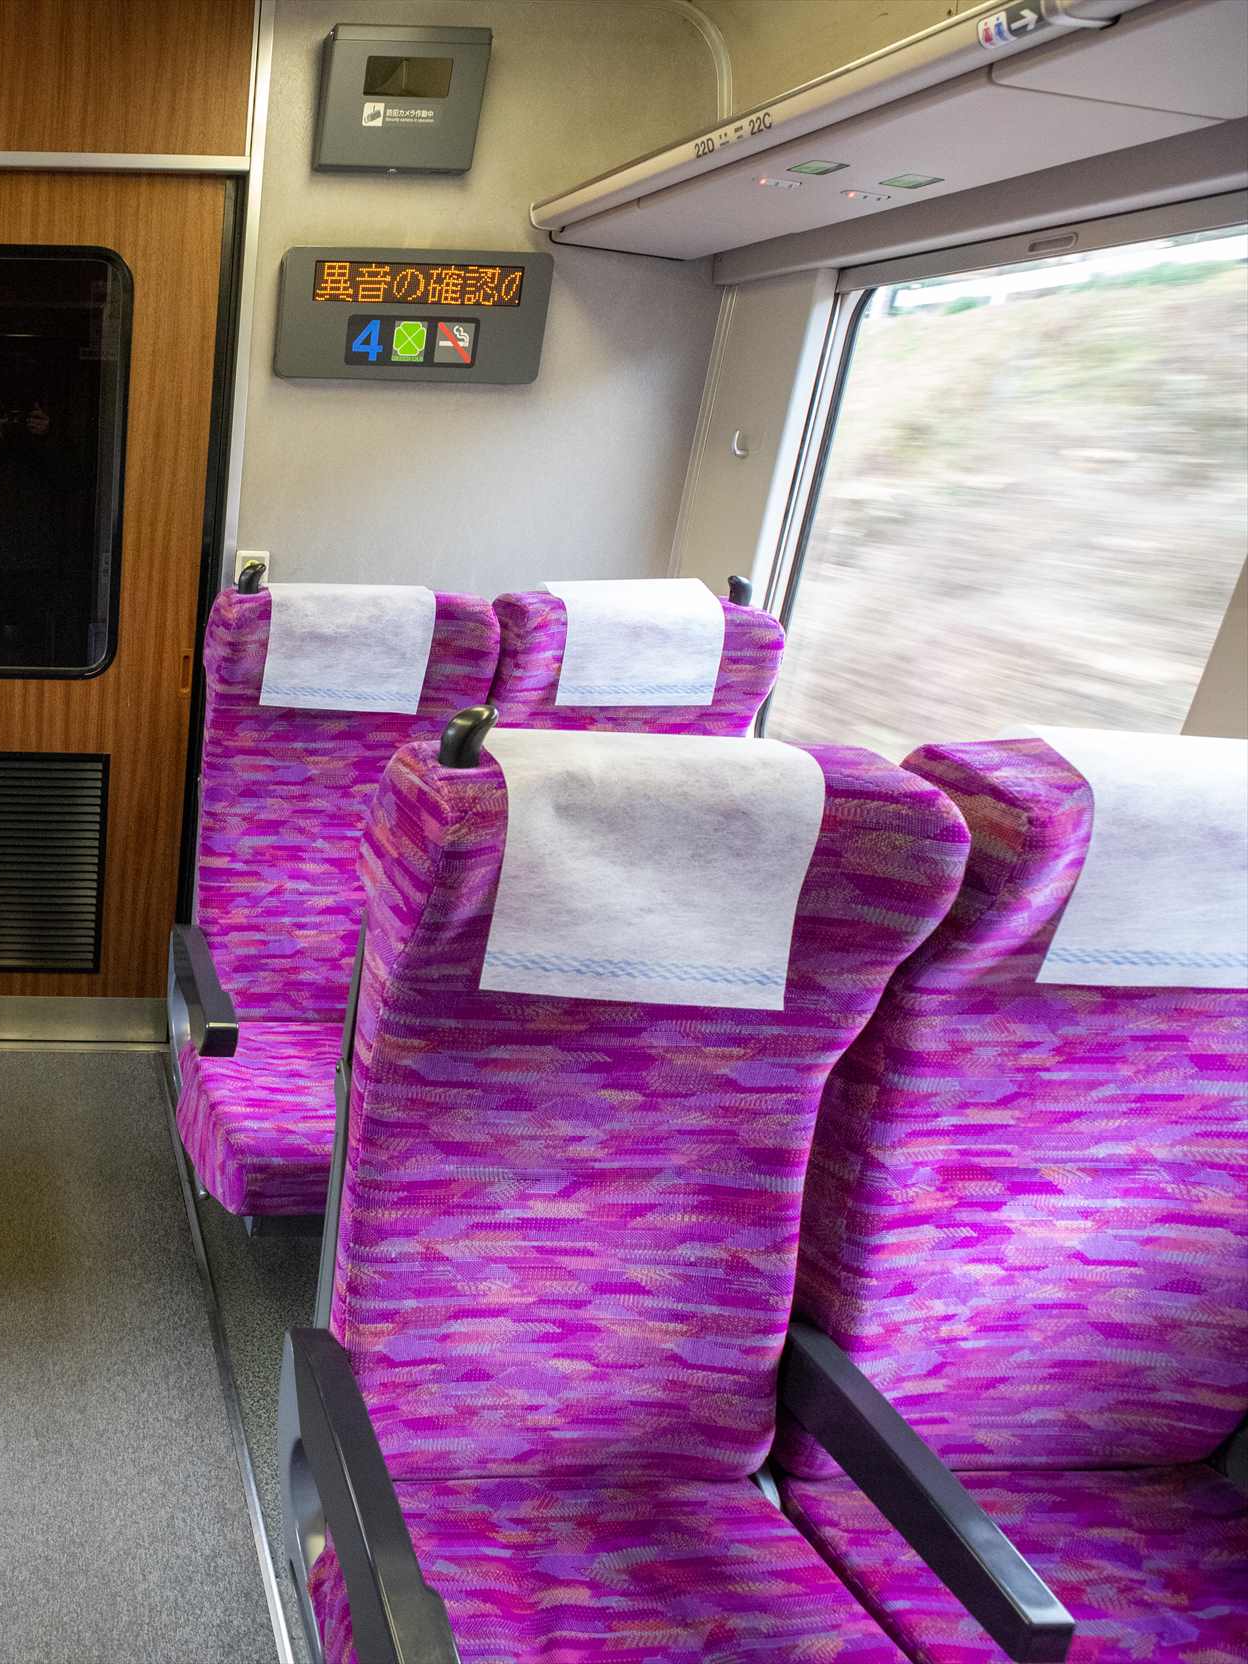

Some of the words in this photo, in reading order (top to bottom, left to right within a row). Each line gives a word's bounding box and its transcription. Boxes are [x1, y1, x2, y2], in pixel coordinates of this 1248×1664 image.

[748, 112, 773, 136] 22C
[694, 137, 715, 159] 22D
[351, 319, 384, 361] 4
